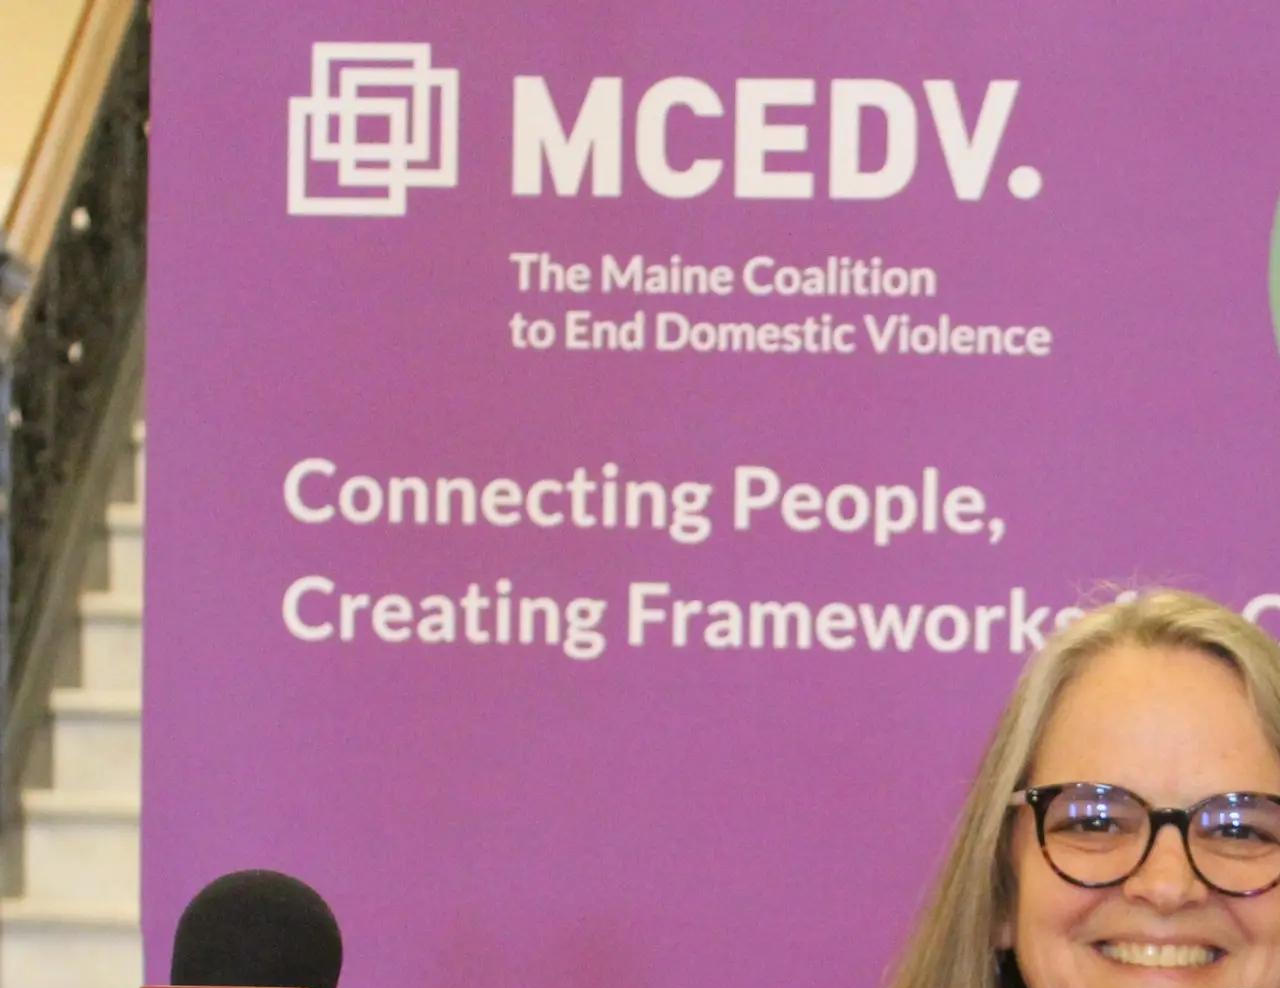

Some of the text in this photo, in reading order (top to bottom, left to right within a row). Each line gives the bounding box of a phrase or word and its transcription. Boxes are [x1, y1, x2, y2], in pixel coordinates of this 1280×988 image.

[511, 75, 1043, 202] MCEDV.
[510, 253, 937, 297] The Maine Coalition
[508, 311, 1053, 357] to End Domestic Violence
[283, 458, 1006, 547] Connecting People,
[282, 576, 607, 660] Creating
